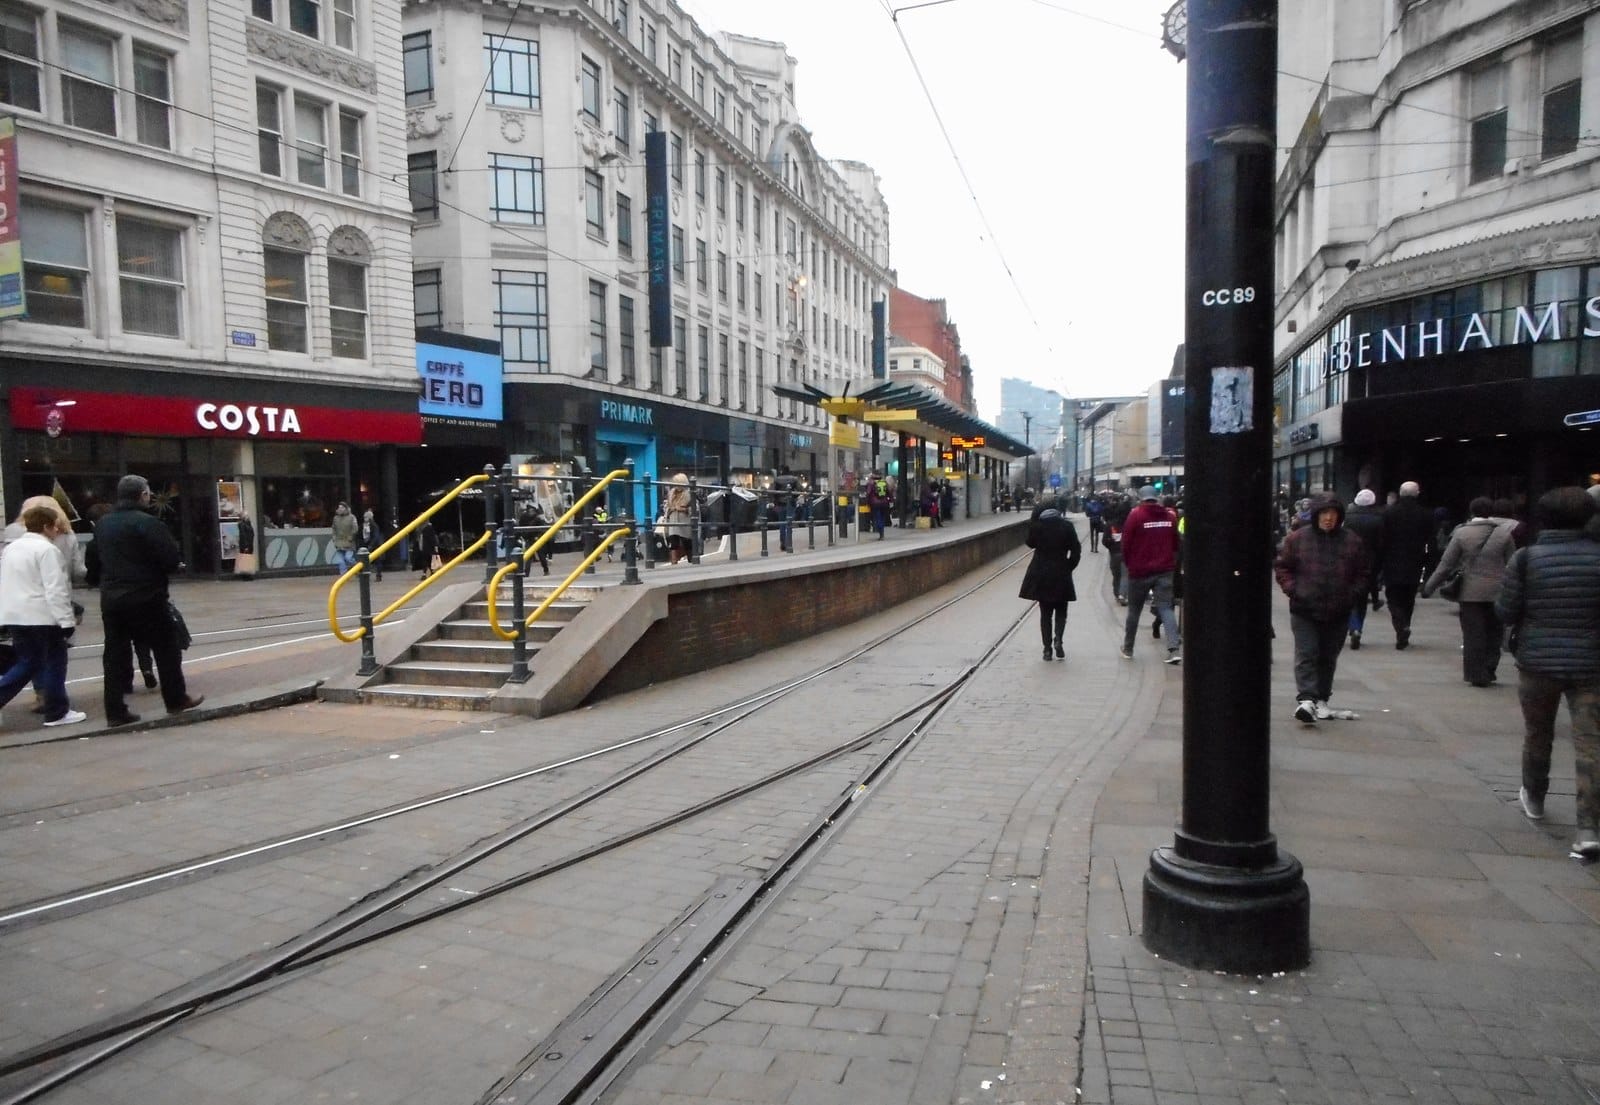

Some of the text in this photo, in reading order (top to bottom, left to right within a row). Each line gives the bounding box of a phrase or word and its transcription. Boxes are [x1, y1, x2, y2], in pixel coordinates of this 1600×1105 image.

[652, 196, 665, 284] PRIMARK
[197, 403, 301, 435] COSTA
[601, 400, 653, 425] PRIMARK
